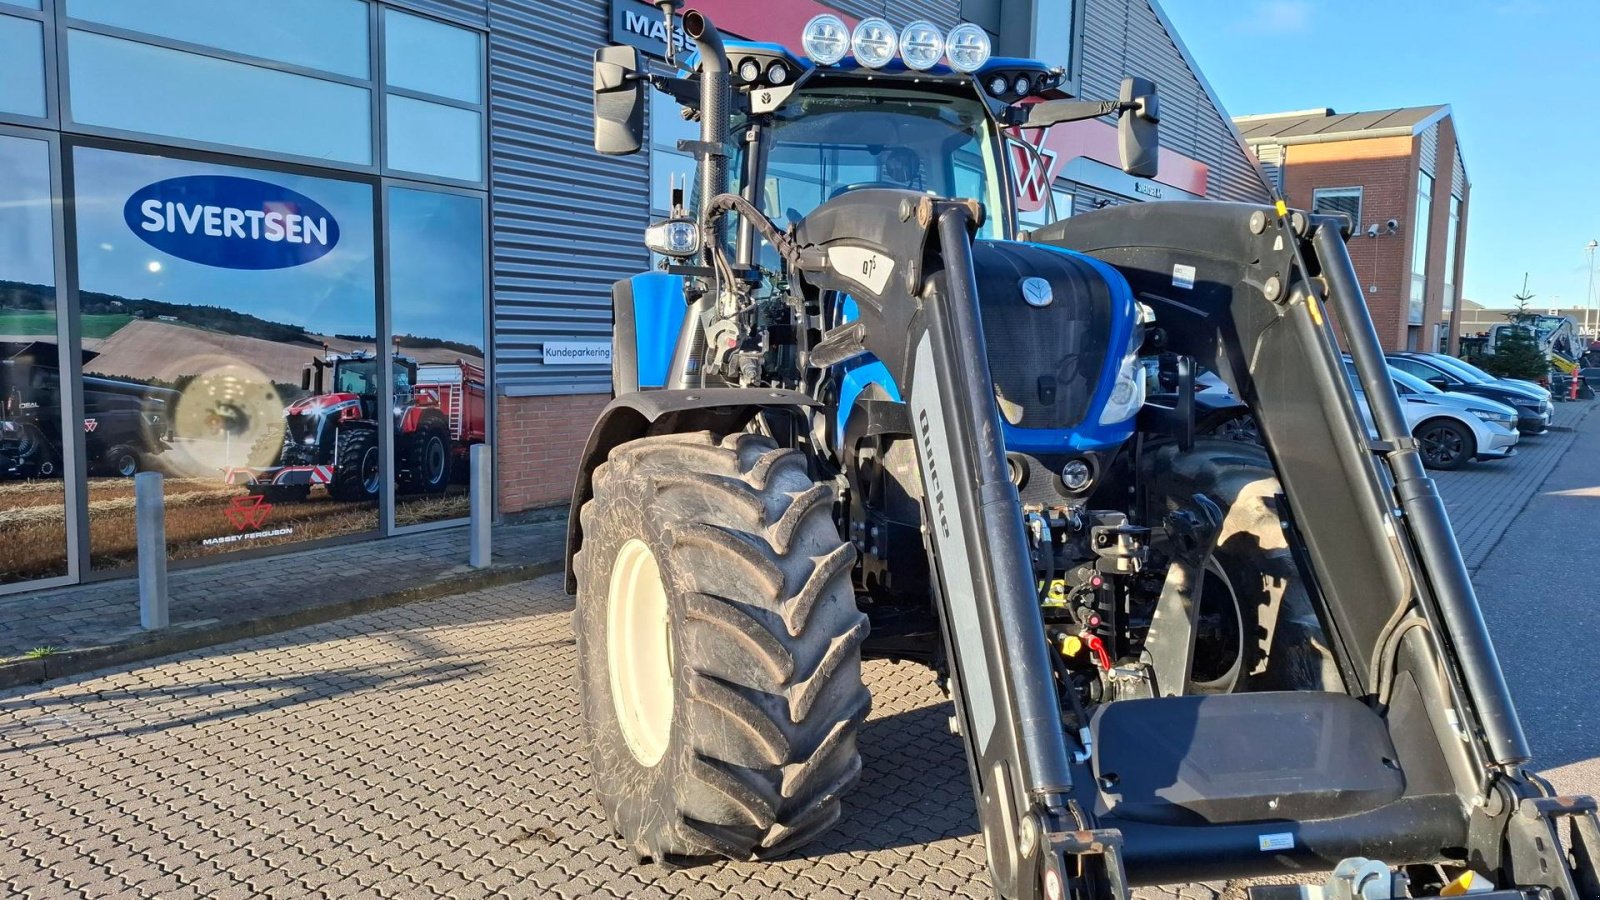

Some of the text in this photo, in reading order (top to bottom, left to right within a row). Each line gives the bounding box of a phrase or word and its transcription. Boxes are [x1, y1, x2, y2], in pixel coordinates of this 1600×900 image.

[141, 199, 328, 246] SIVERTSEN
[545, 346, 610, 359] Kundeparkering
[919, 408, 950, 539] Quicke
[202, 527, 293, 546] MASSEY FERGUSON
